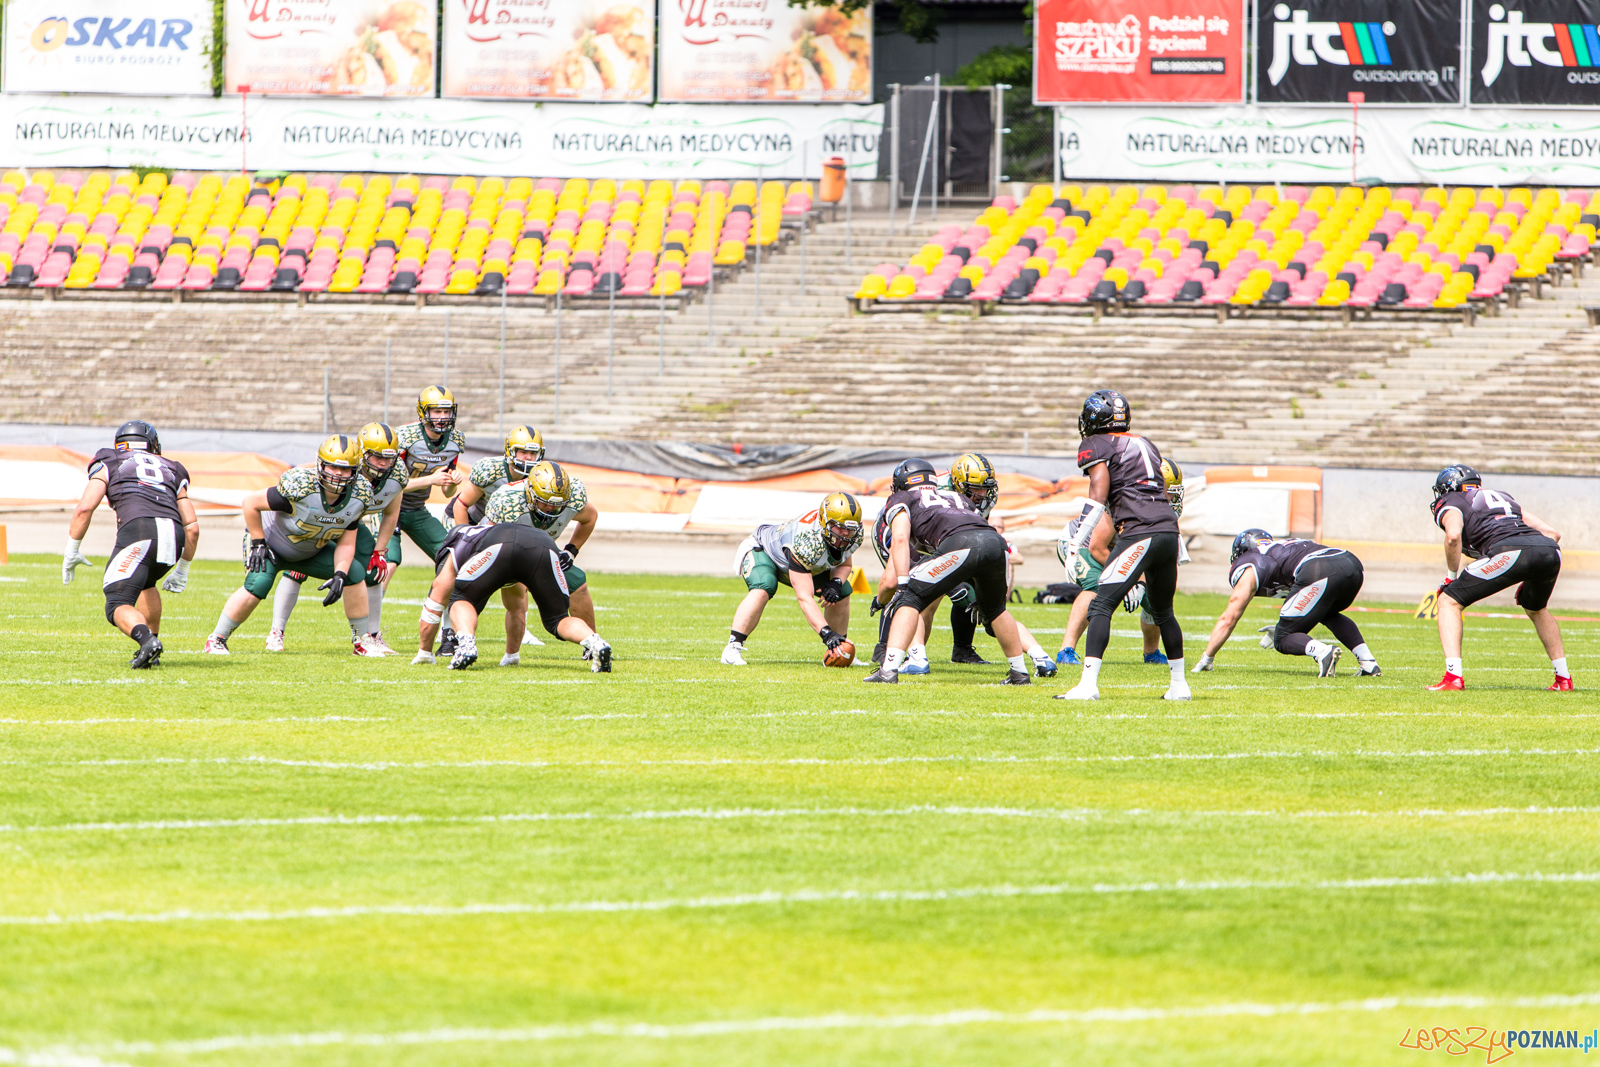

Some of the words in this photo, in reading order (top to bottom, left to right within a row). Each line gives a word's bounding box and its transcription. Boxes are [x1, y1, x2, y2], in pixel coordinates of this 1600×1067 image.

[494, 10, 555, 27] Danuty
[711, 12, 774, 30] Danuty
[1149, 15, 1205, 32] Podziel
[1206, 16, 1230, 35] się
[30, 16, 193, 52] OSKAR
[1148, 35, 1207, 54] życiem!
[1055, 37, 1141, 58] SZPIKU
[1267, 3, 1350, 87] jtc
[1481, 3, 1564, 87] jtc
[75, 56, 115, 65] BIURO
[1353, 68, 1438, 86] outsourcing
[1442, 66, 1456, 81] IT
[16, 122, 135, 141] NATURALNA
[142, 124, 253, 143] MEDYCYNA
[284, 126, 408, 145] NATURALNA
[412, 128, 522, 149] MEDYCYNA
[553, 133, 673, 152] NATURALNA
[681, 134, 792, 152] MEDYCYNA
[823, 133, 879, 152] NATU
[1127, 133, 1248, 154] NATURALNA
[1256, 135, 1365, 155] MEDYCYNA
[1412, 137, 1533, 156] NATURALNA
[1541, 138, 1600, 158] MEDY
[134, 453, 164, 484] 8
[1482, 489, 1513, 516] 4
[466, 551, 492, 576] Mitutoyo
[928, 554, 959, 579] Mitutoyo
[1118, 545, 1145, 577] Mitutoyo
[1481, 555, 1510, 576] Mitutoyo
[1294, 586, 1320, 612] Mitutoyo
